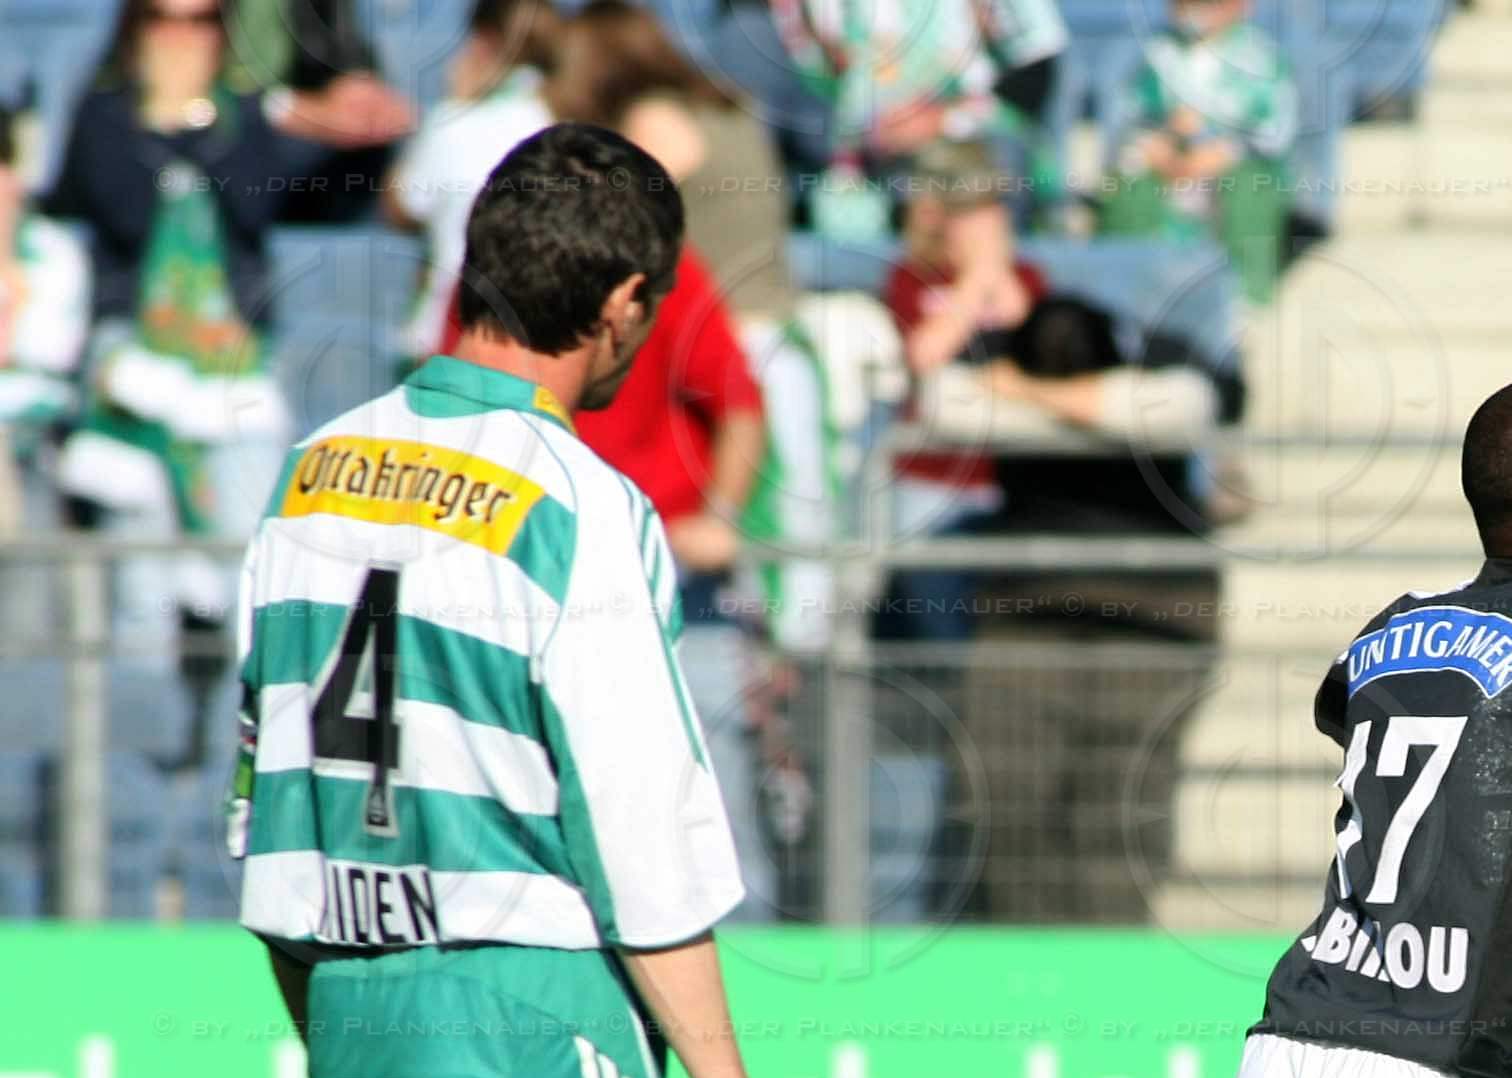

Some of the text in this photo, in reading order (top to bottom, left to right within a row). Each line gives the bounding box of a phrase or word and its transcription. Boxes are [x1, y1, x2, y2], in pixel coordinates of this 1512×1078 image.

[299, 444, 514, 523] Ottakringer
[309, 567, 401, 829] 4
[320, 863, 440, 943] IDEN
